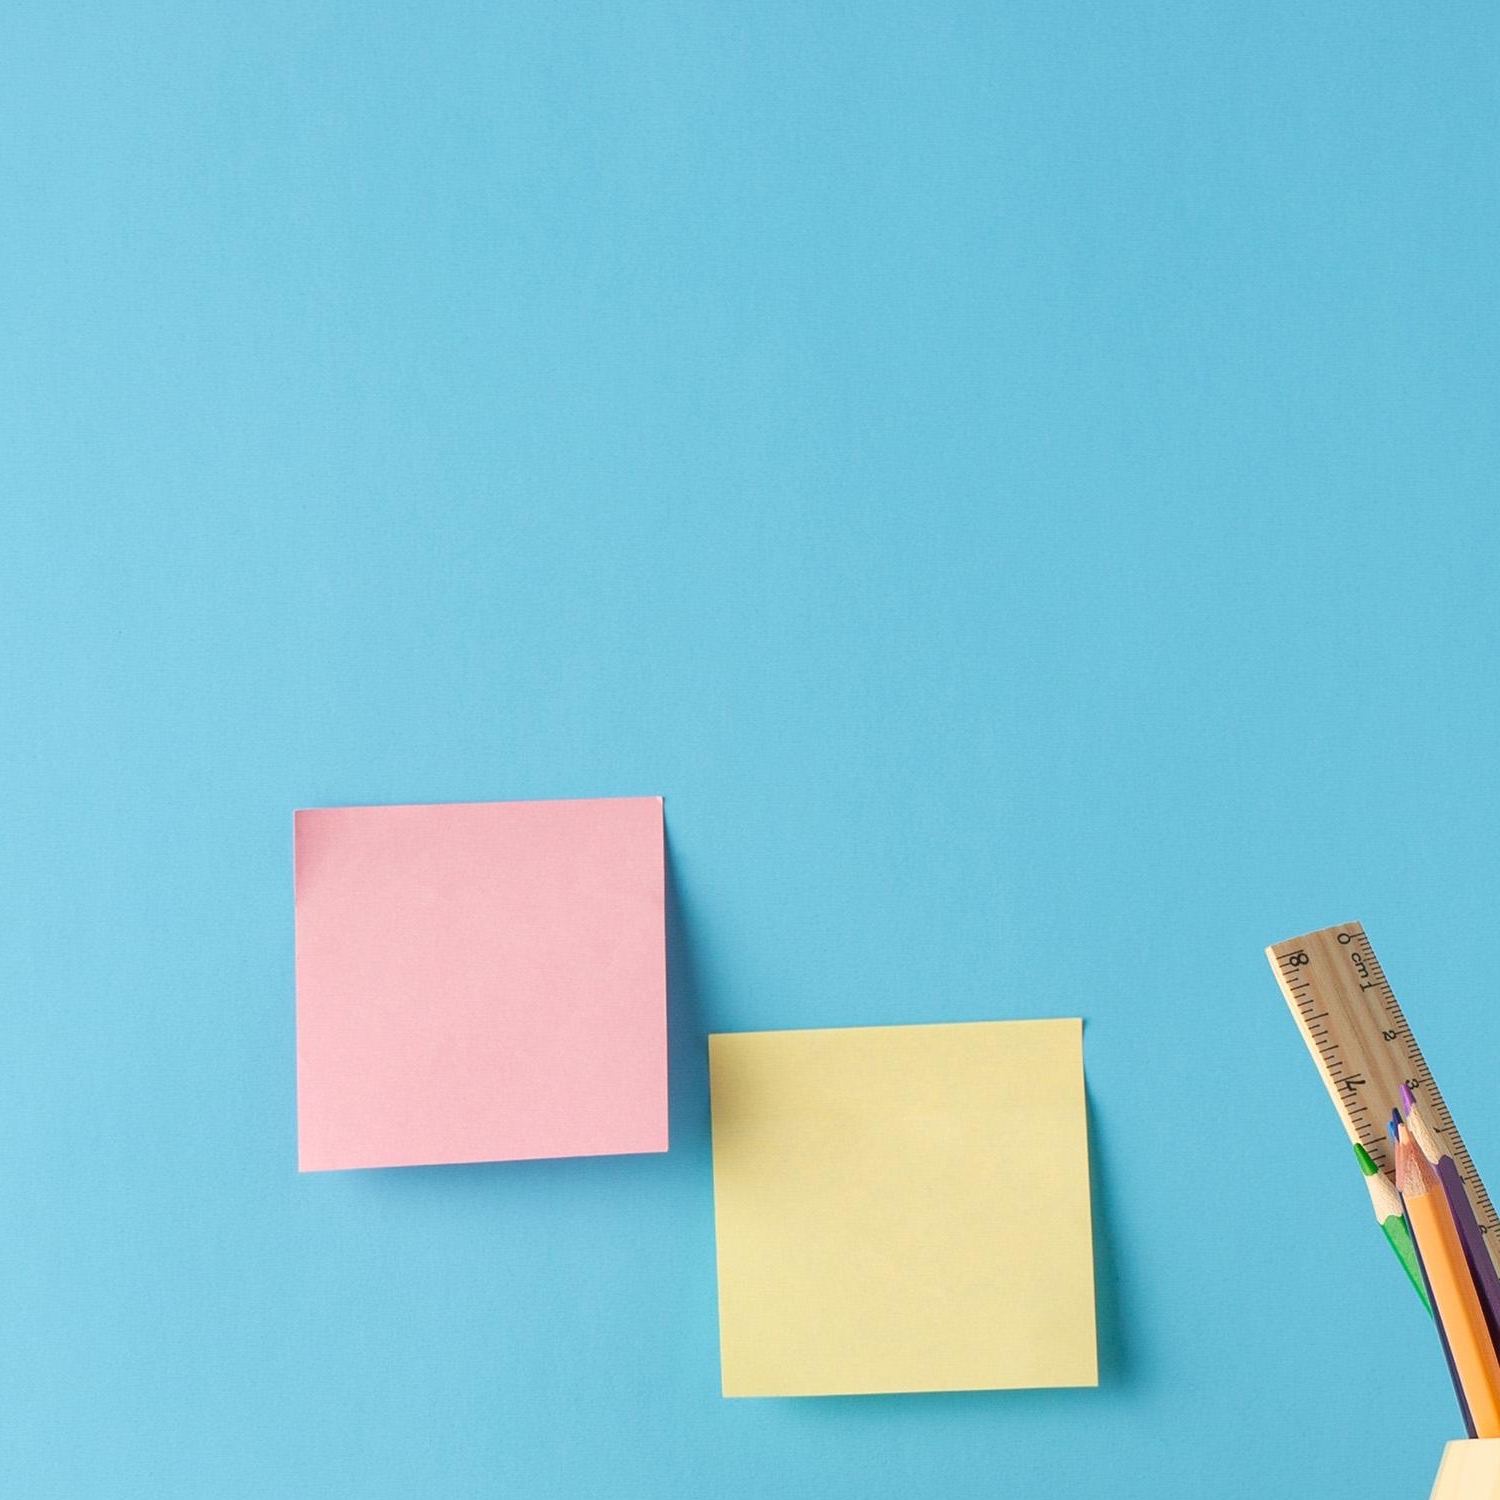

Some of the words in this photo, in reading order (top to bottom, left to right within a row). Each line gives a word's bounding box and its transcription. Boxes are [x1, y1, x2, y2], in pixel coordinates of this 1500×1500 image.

[1351, 952, 1371, 979] cm
[1359, 981, 1373, 993] 1
[1288, 952, 1310, 967] 8
[1344, 1078, 1367, 1092] 7
[1381, 1029, 1397, 1043] 2
[1404, 1078, 1420, 1090] 3
